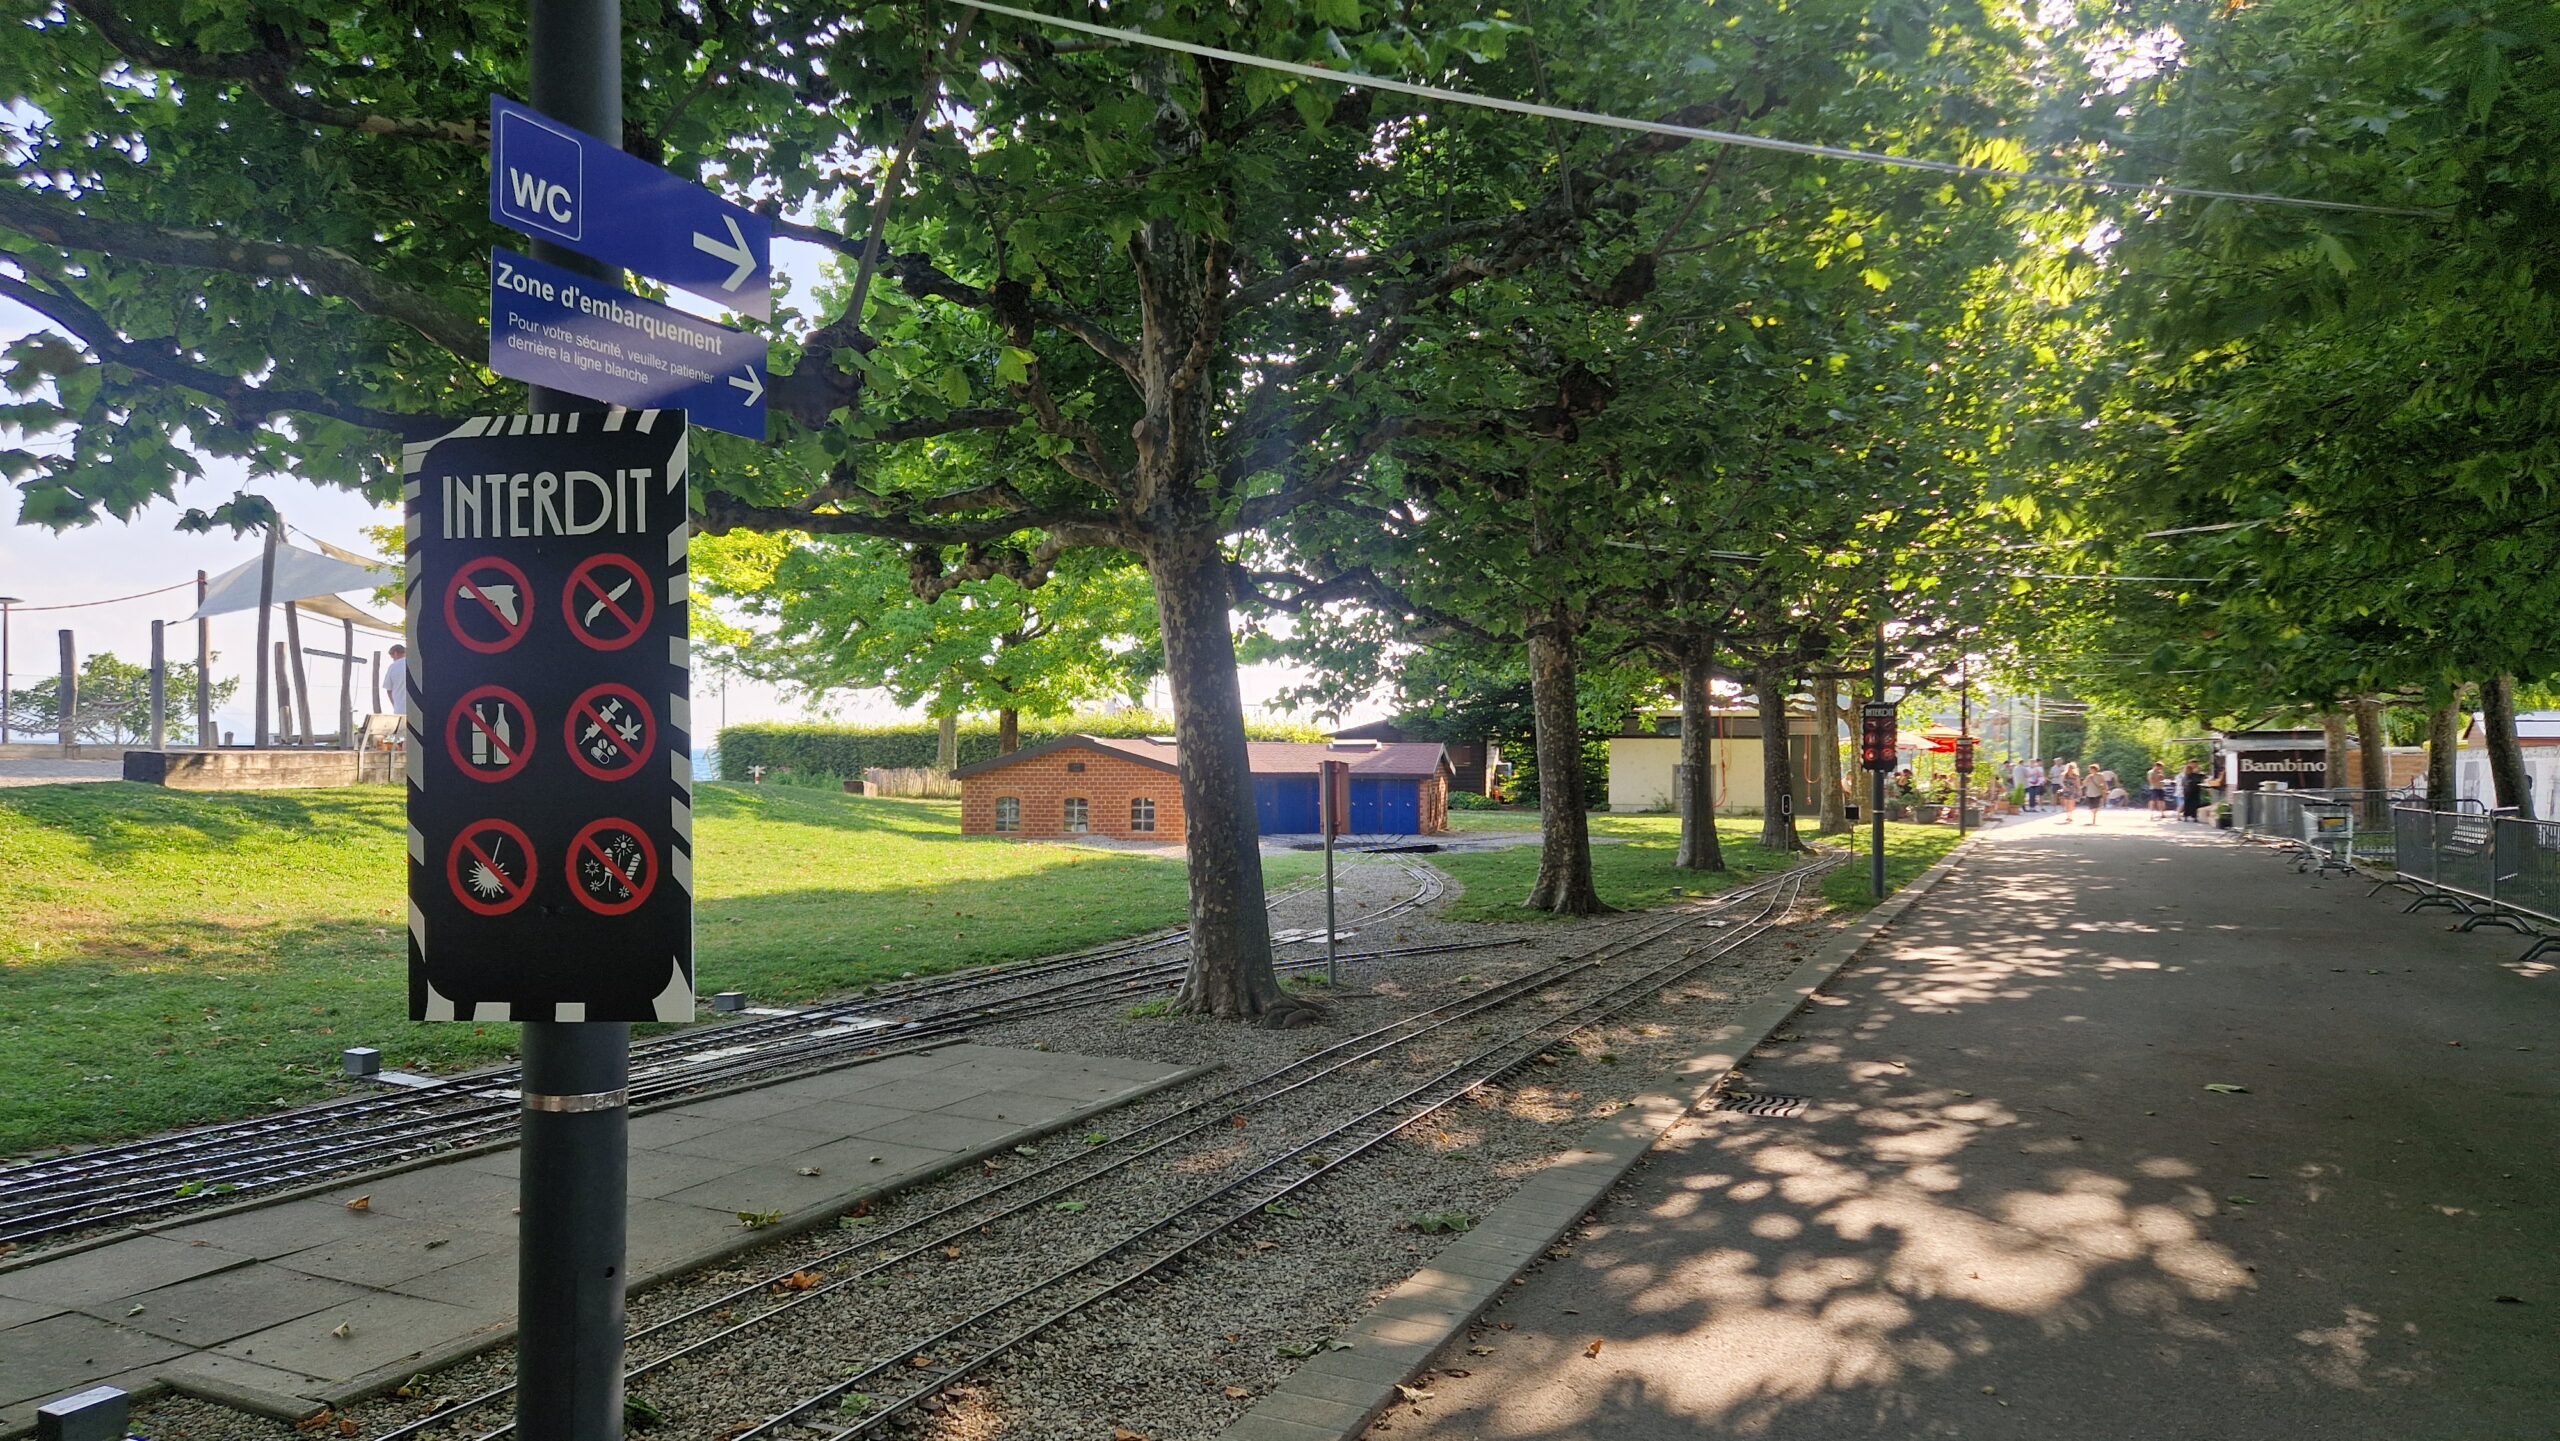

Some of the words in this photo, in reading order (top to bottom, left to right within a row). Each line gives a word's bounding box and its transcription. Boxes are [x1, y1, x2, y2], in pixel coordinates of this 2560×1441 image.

[510, 166, 572, 224] WC
[497, 262, 555, 302] Zone
[561, 286, 722, 356] d'embarquement
[508, 312, 539, 333] Pour
[542, 325, 573, 343] votre
[576, 334, 624, 360] sécurité,
[627, 350, 668, 371] veuillez
[670, 363, 714, 385] patienter
[508, 334, 557, 360] derrière
[560, 348, 570, 363] la
[574, 351, 602, 371] ligne
[605, 360, 649, 385] blanche
[442, 468, 652, 540] INTERDIT
[2240, 758, 2327, 772] Bambino
